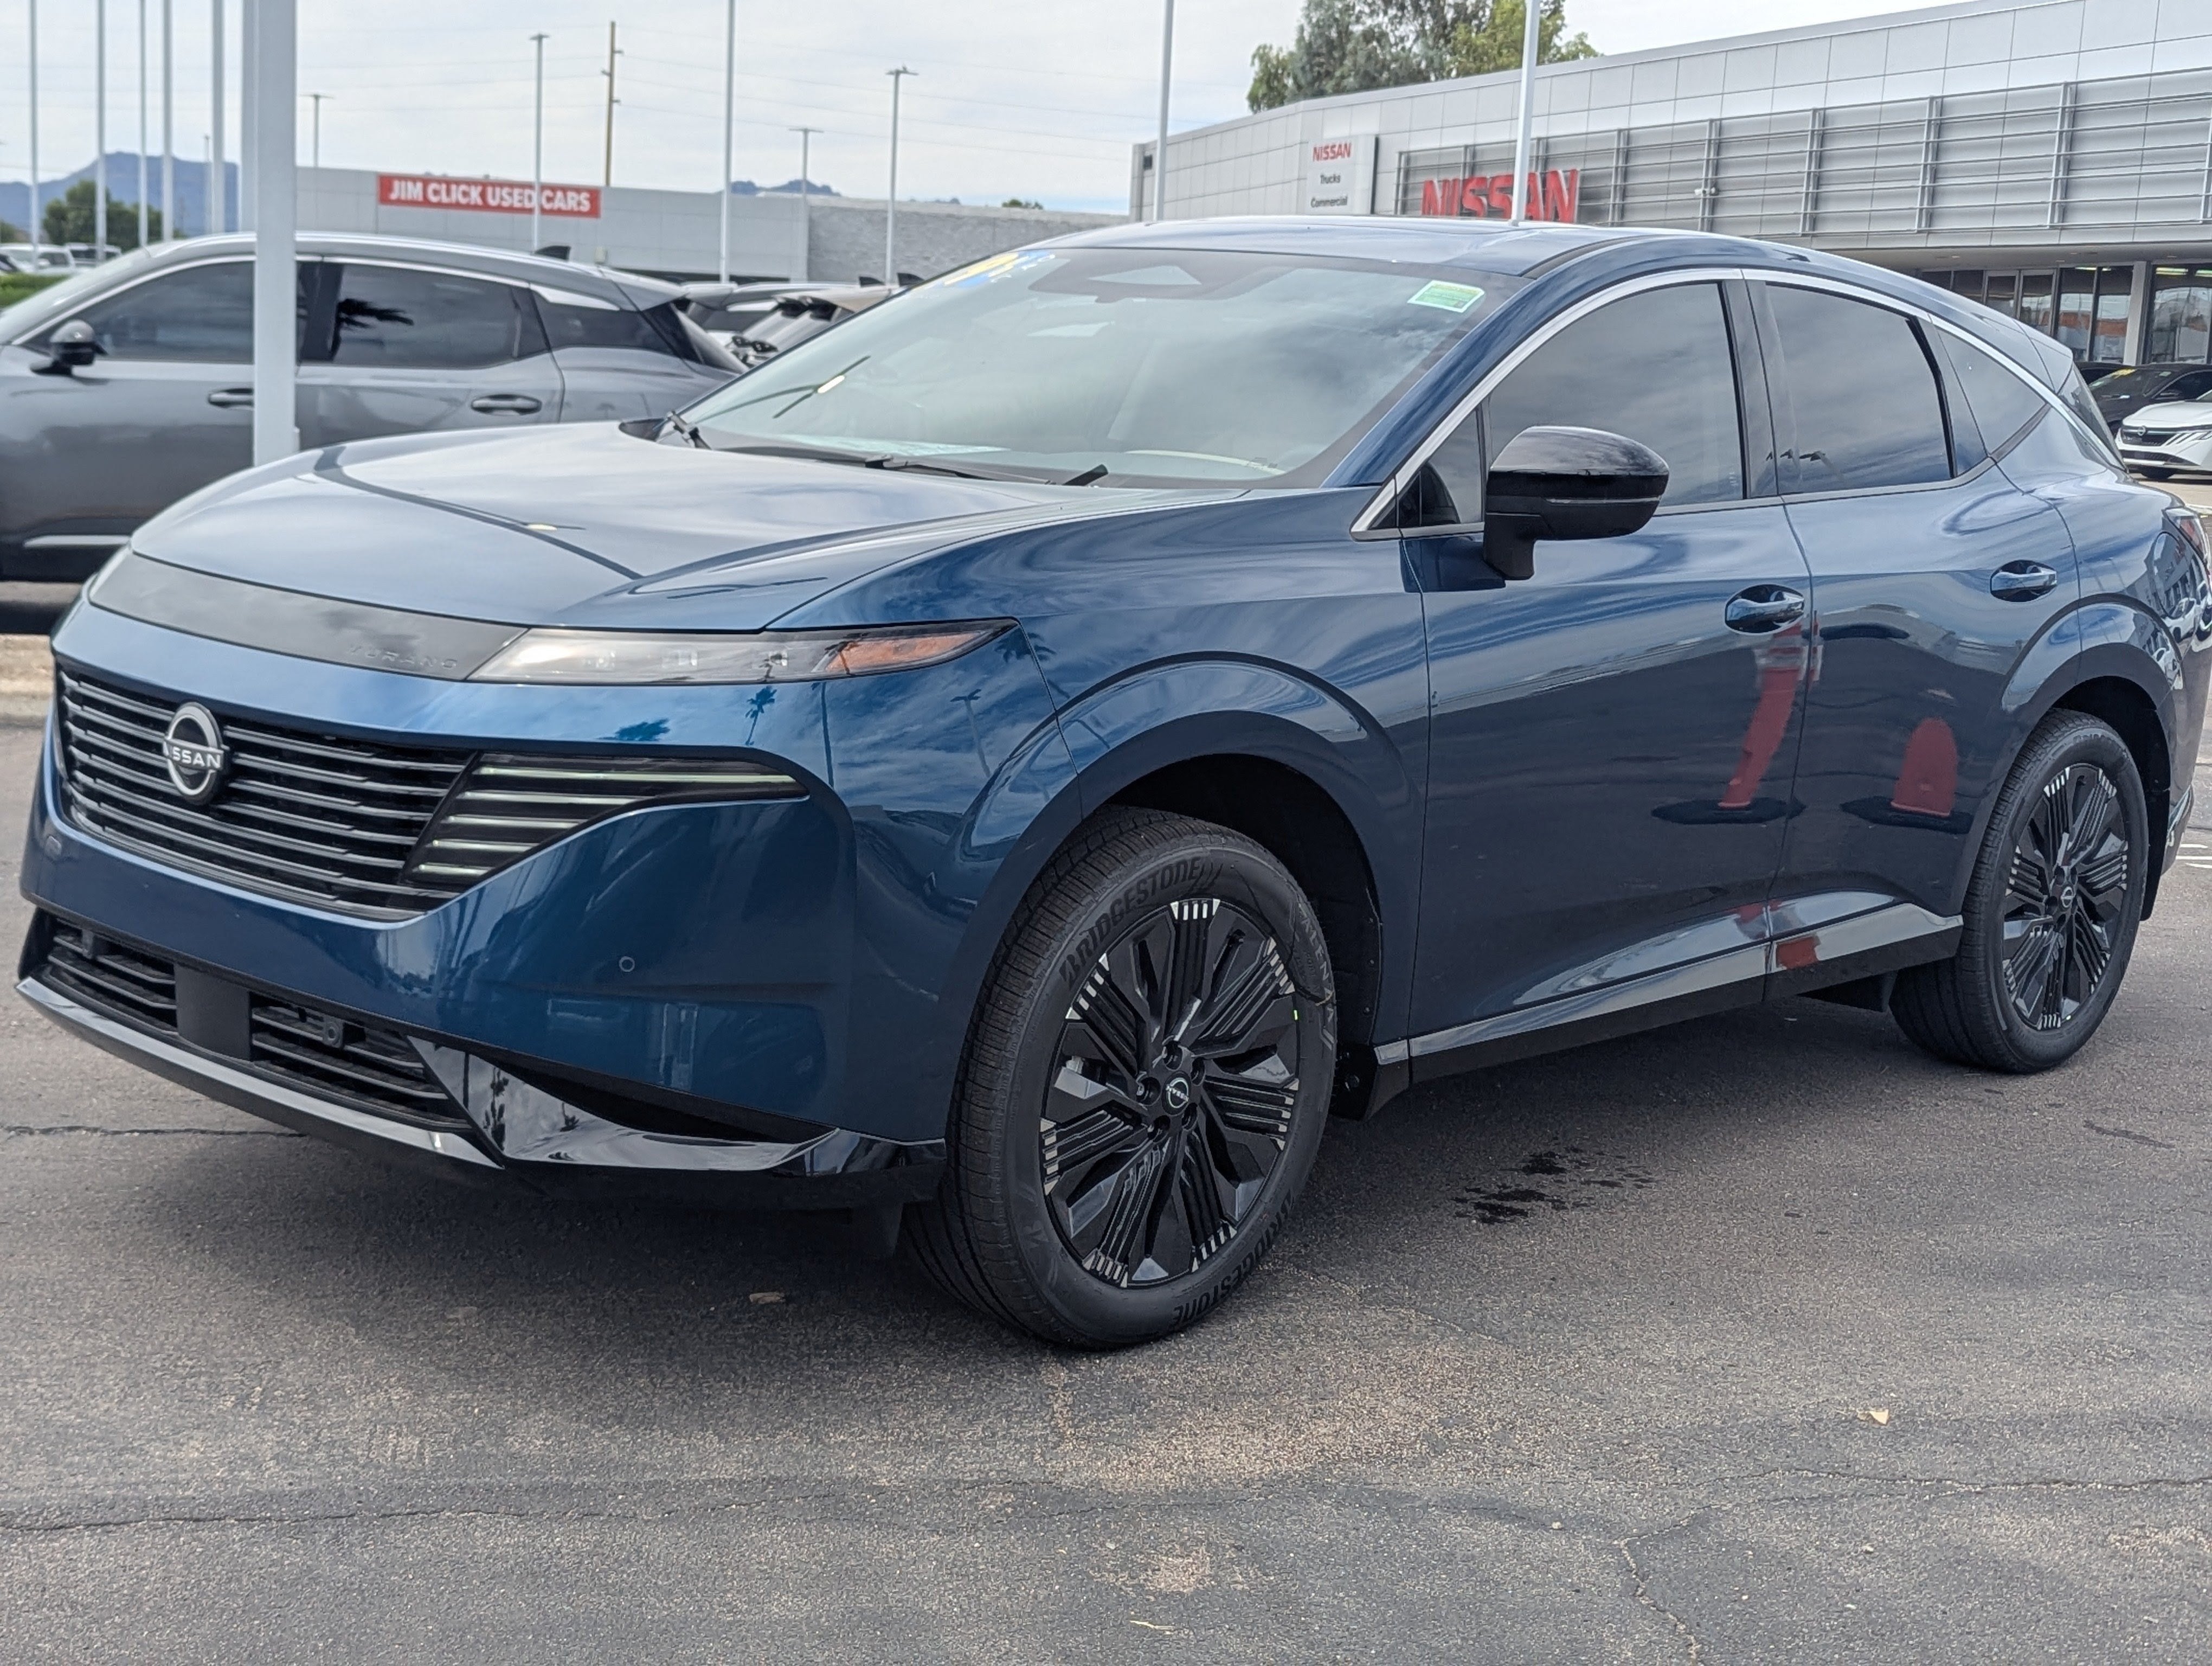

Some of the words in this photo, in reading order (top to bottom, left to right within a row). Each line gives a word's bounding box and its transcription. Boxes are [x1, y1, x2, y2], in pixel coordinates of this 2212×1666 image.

[1313, 143, 1351, 161] NISSAN
[1320, 174, 1341, 184] Trucks
[390, 180, 423, 201] JIM
[427, 183, 483, 206] CLICK
[487, 187, 536, 209] USED
[542, 191, 591, 213] CARS
[1310, 196, 1348, 208] Commercial
[1422, 168, 1579, 223] NISSAN
[1059, 857, 1201, 991] BRIDGESTONE
